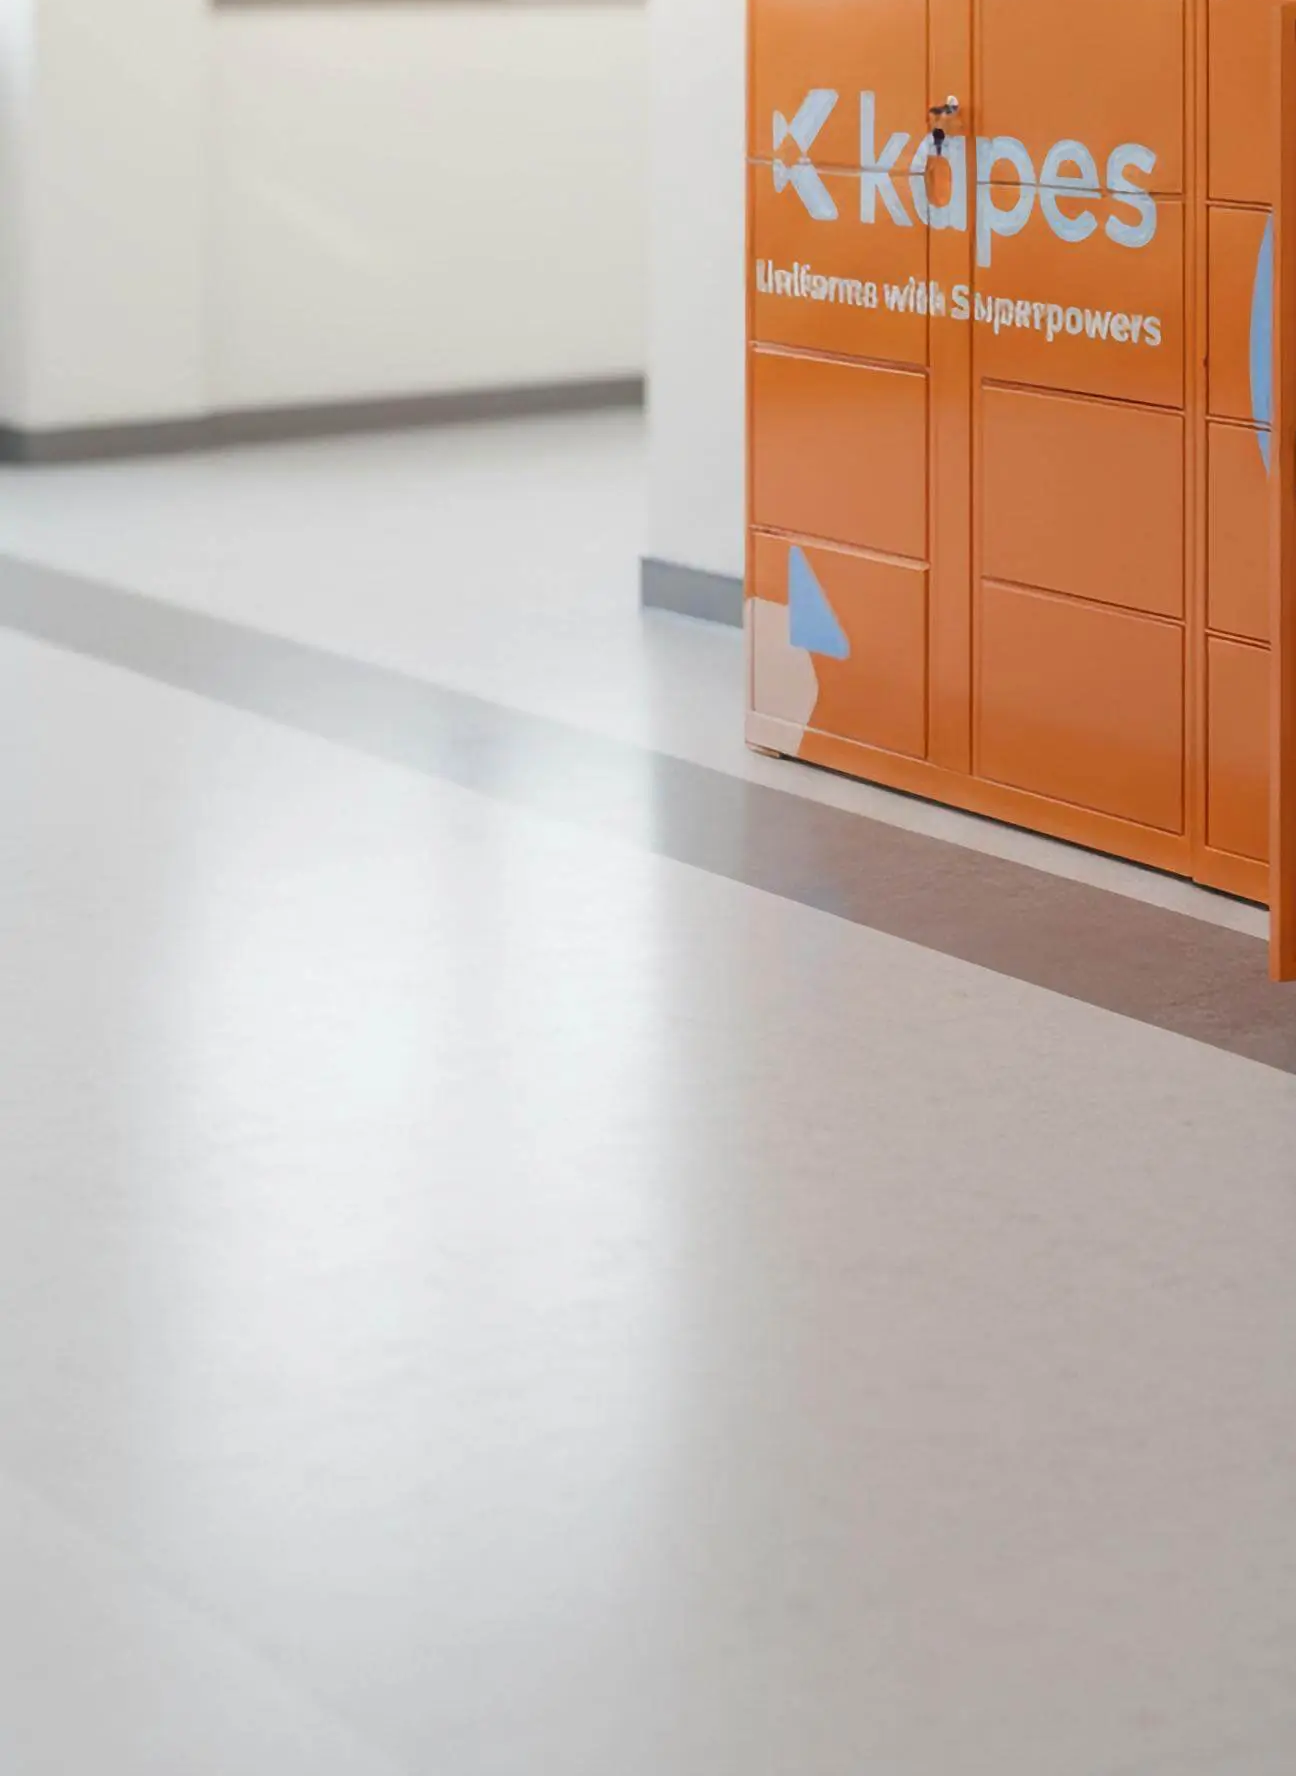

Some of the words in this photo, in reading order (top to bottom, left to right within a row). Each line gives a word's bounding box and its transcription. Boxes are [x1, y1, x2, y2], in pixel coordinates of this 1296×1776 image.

[859, 90, 1158, 268] kapes
[883, 276, 946, 317] with
[950, 284, 1162, 346] Superpowers
